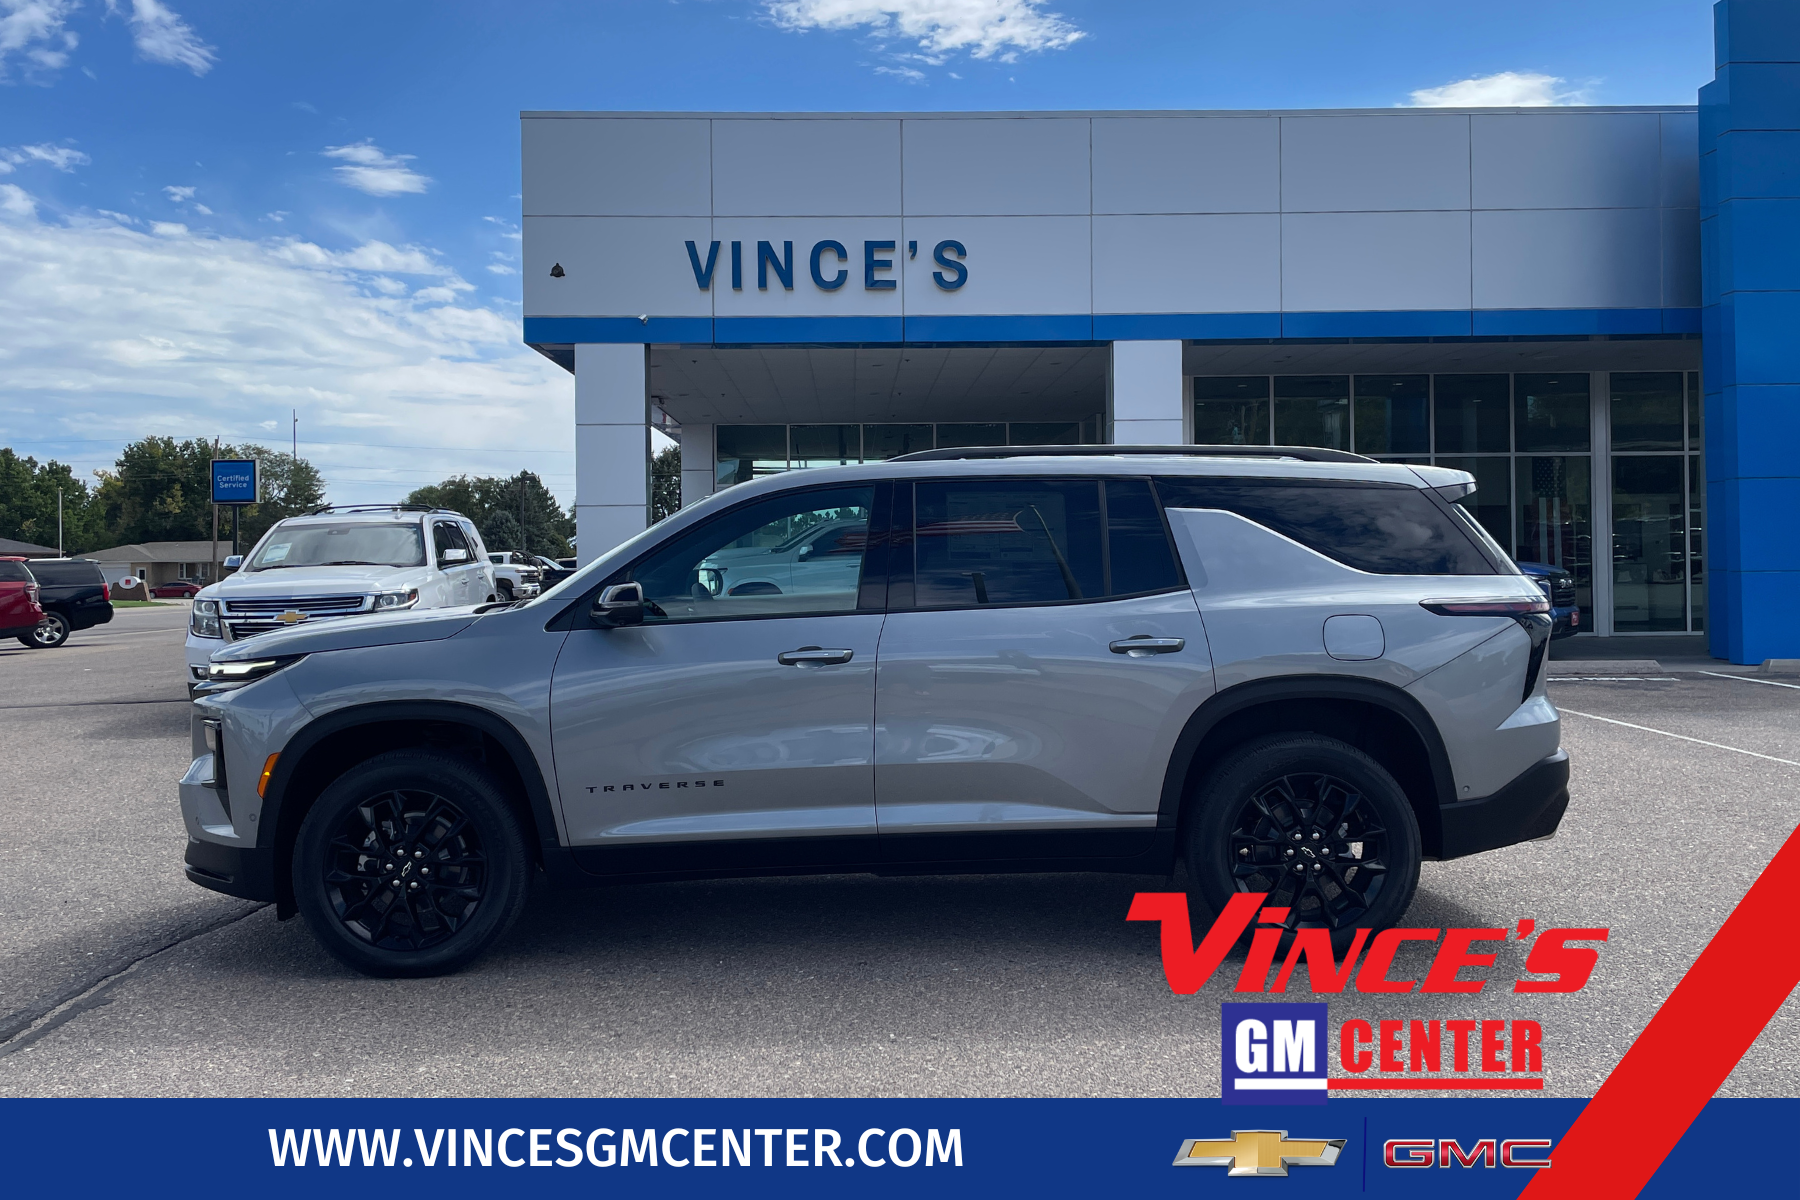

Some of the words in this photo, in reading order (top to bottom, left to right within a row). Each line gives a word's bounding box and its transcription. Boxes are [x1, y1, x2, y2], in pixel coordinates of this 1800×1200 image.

[685, 240, 968, 291] VINCE'S
[219, 481, 248, 489] Service
[585, 779, 725, 794] TRAVERSE
